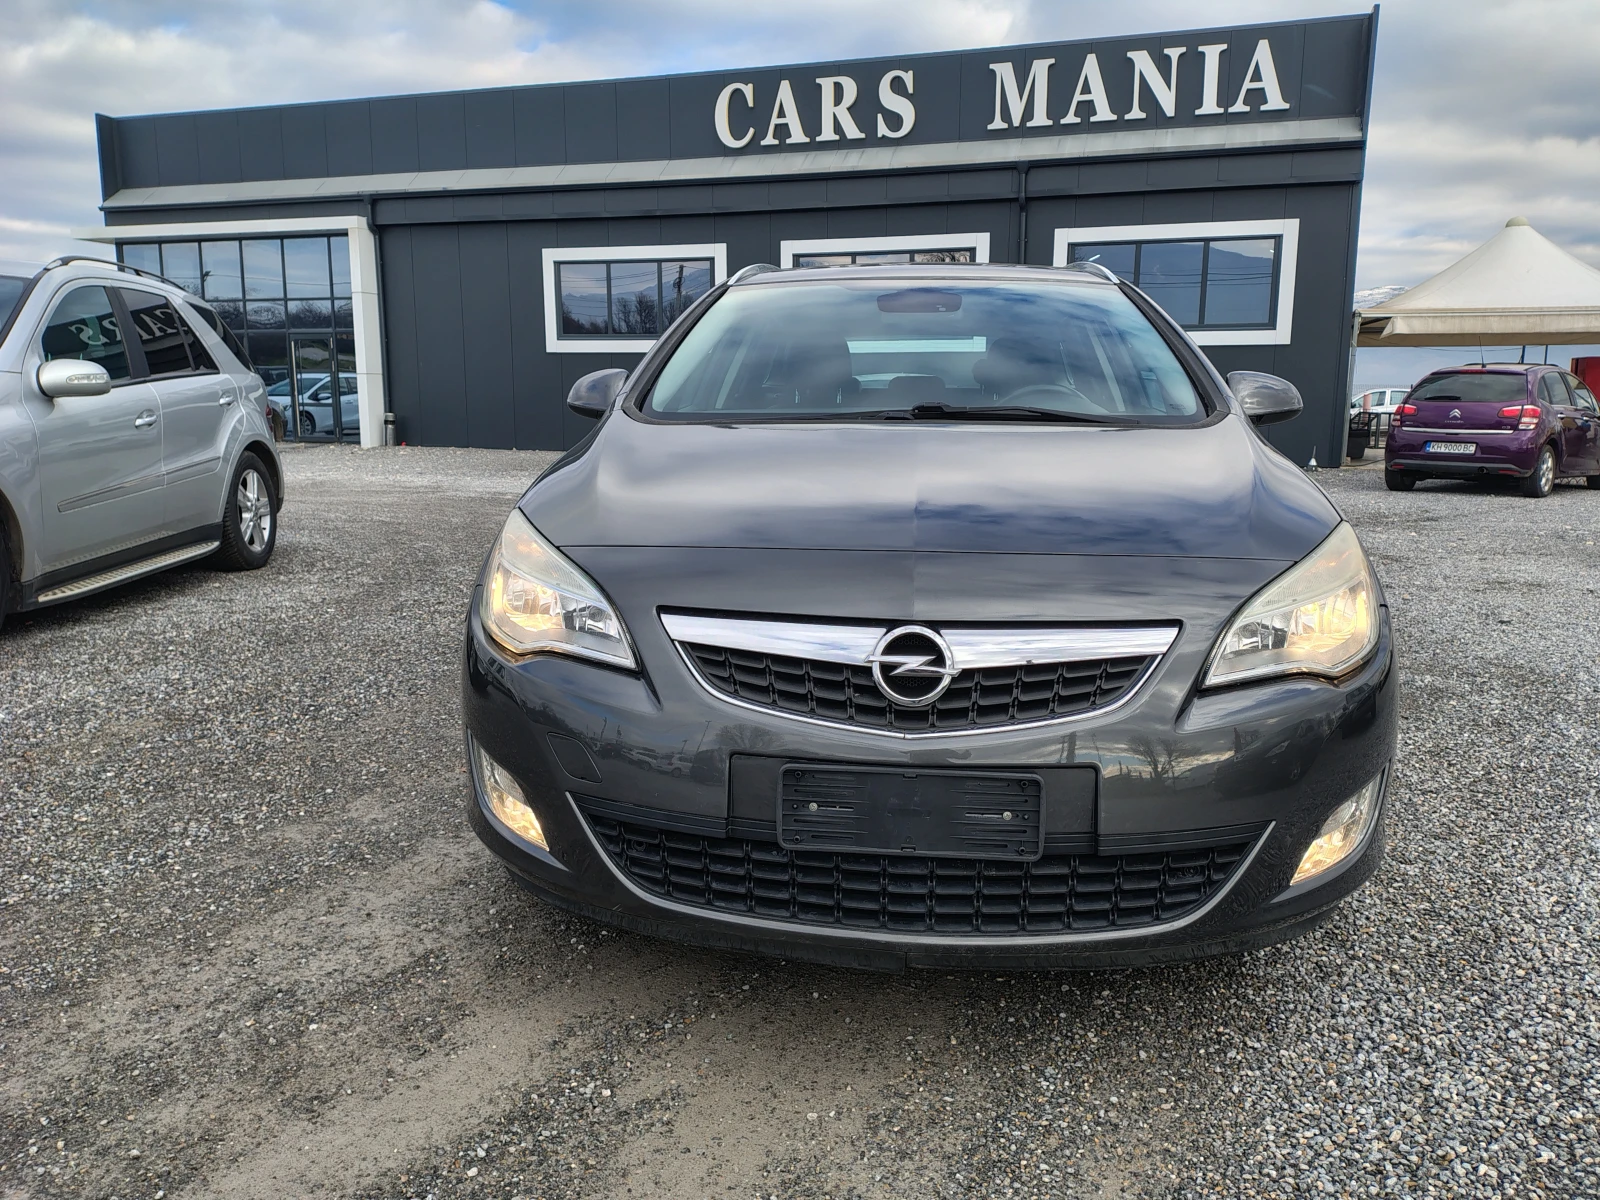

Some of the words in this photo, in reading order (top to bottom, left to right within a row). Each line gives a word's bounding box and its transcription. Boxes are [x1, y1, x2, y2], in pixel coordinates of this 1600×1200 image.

[714, 69, 917, 149] CARS
[987, 38, 1291, 131] MANIA
[1431, 443, 1443, 451] KH
[1443, 443, 1462, 452] 9000
[1462, 444, 1474, 452] BC
